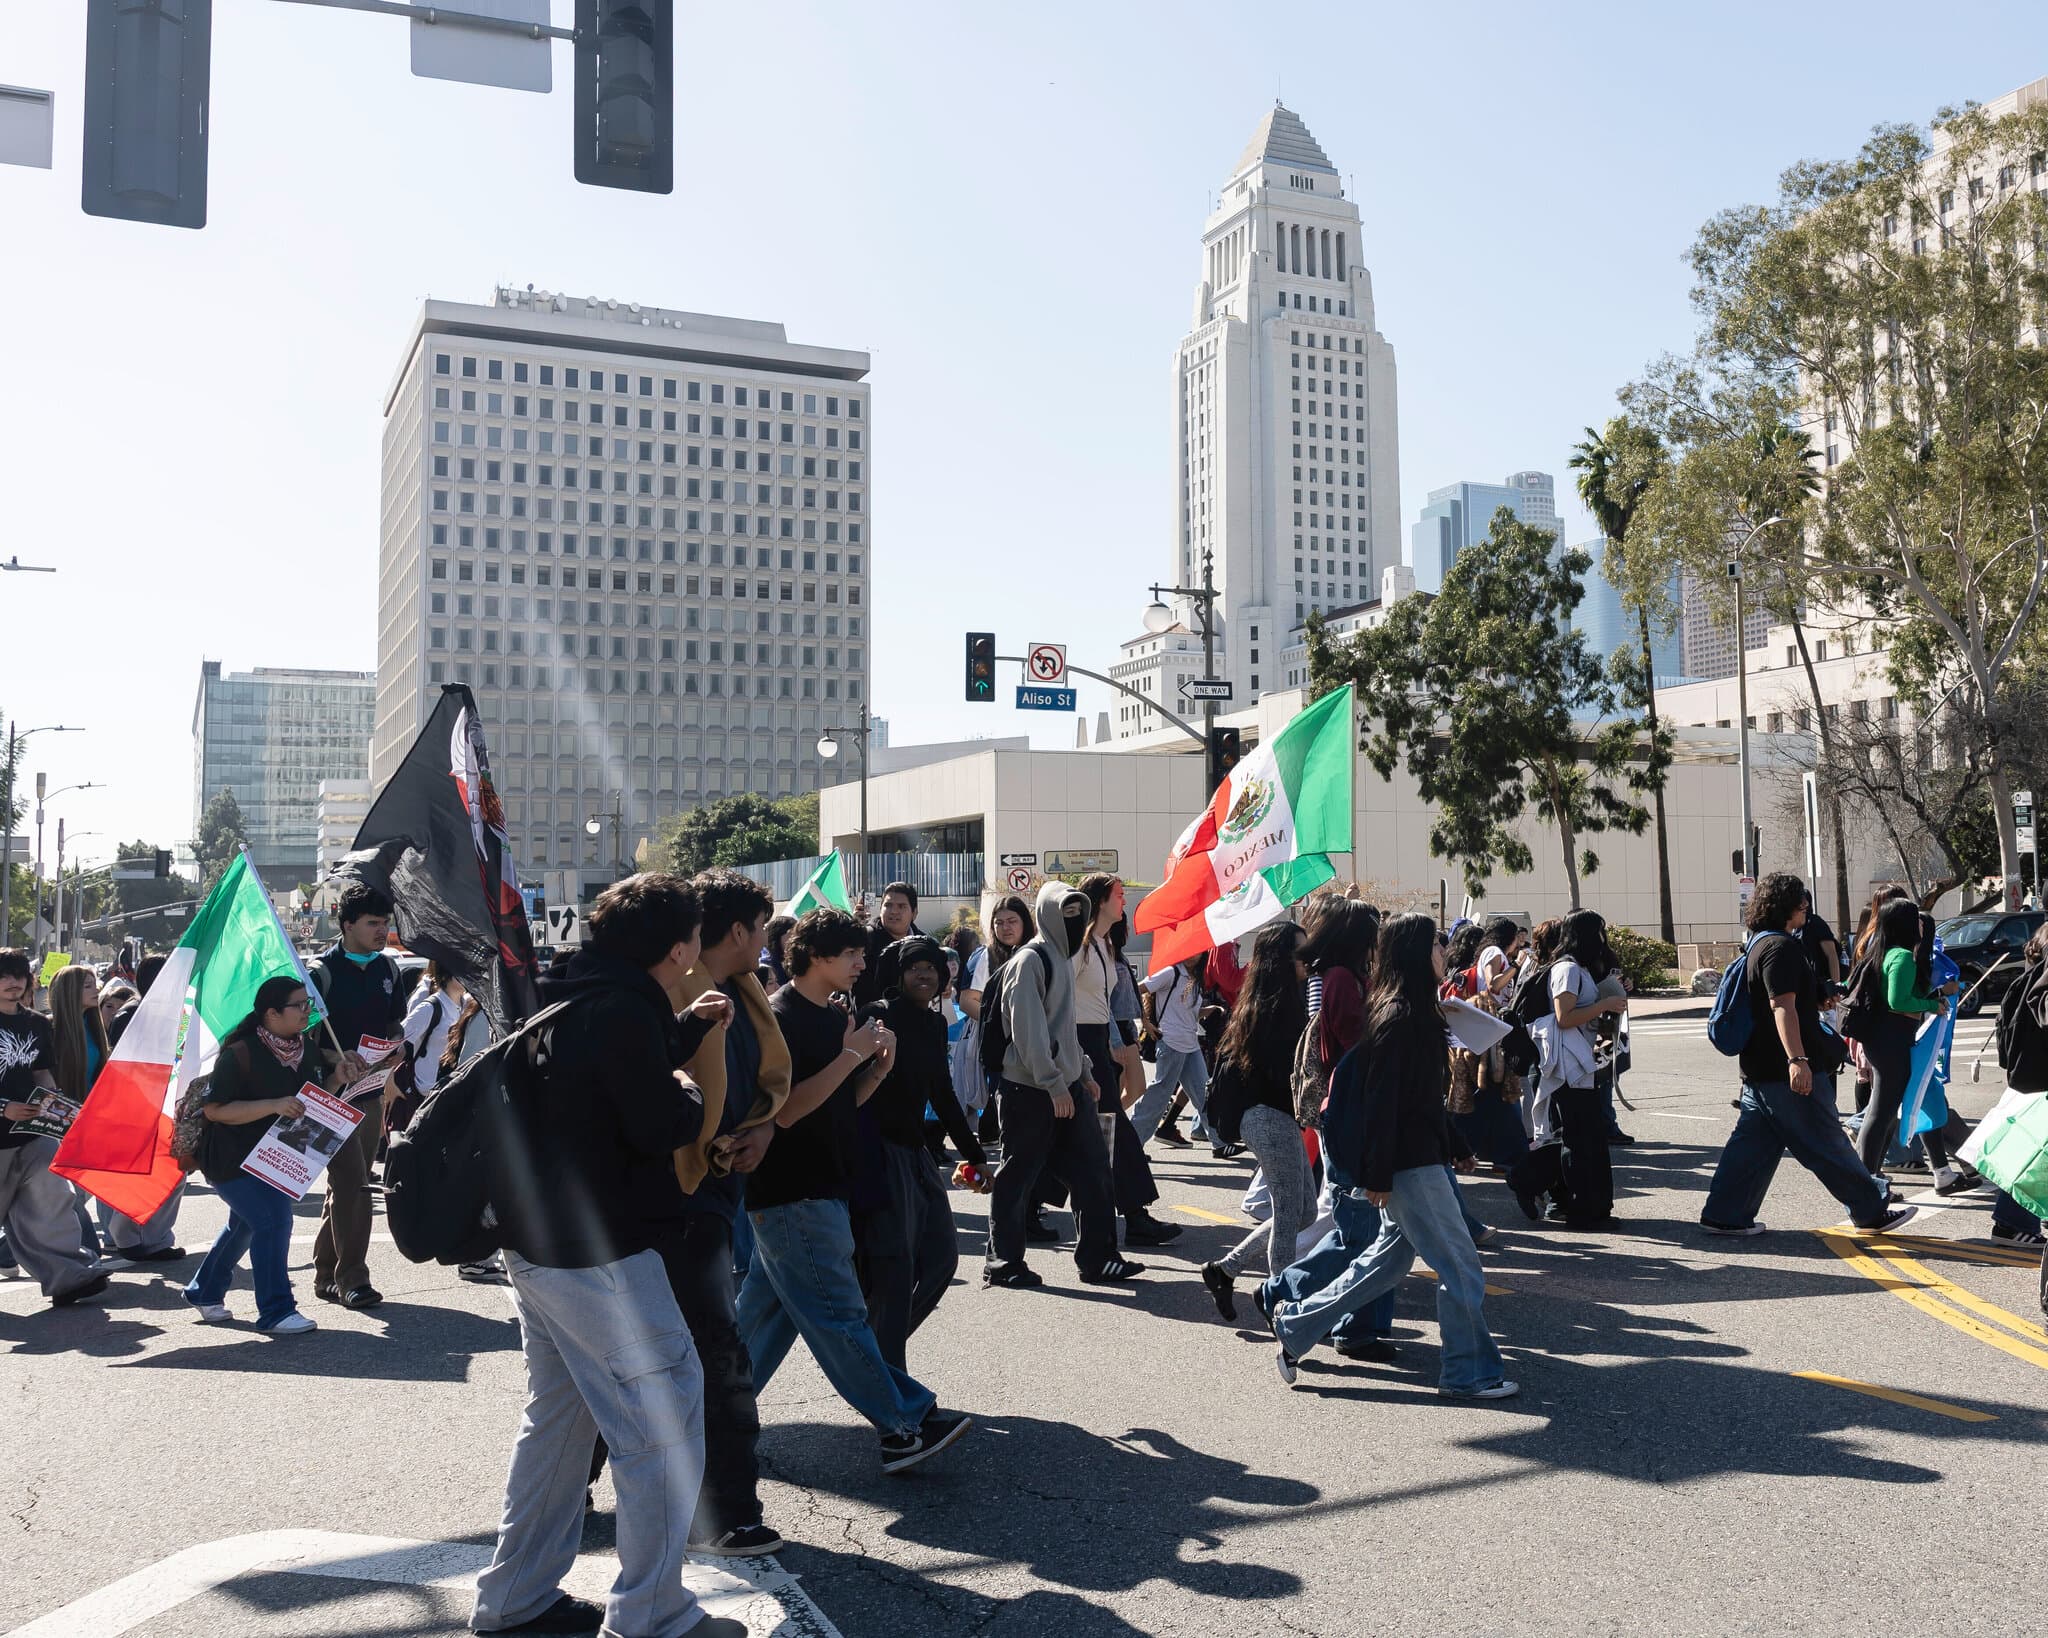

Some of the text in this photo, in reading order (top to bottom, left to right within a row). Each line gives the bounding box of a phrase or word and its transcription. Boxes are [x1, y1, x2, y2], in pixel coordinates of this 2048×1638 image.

[1021, 692, 1071, 706] Aliso St
[1194, 686, 1227, 695] ONE WAY
[309, 1090, 328, 1105] MOST
[256, 1153, 306, 1184] MINNEAPOLIS
[257, 1147, 281, 1164] RENEE
[281, 1161, 303, 1177] GOOD
[303, 1174, 312, 1182] IN
[267, 1147, 309, 1173] EXECUTING
